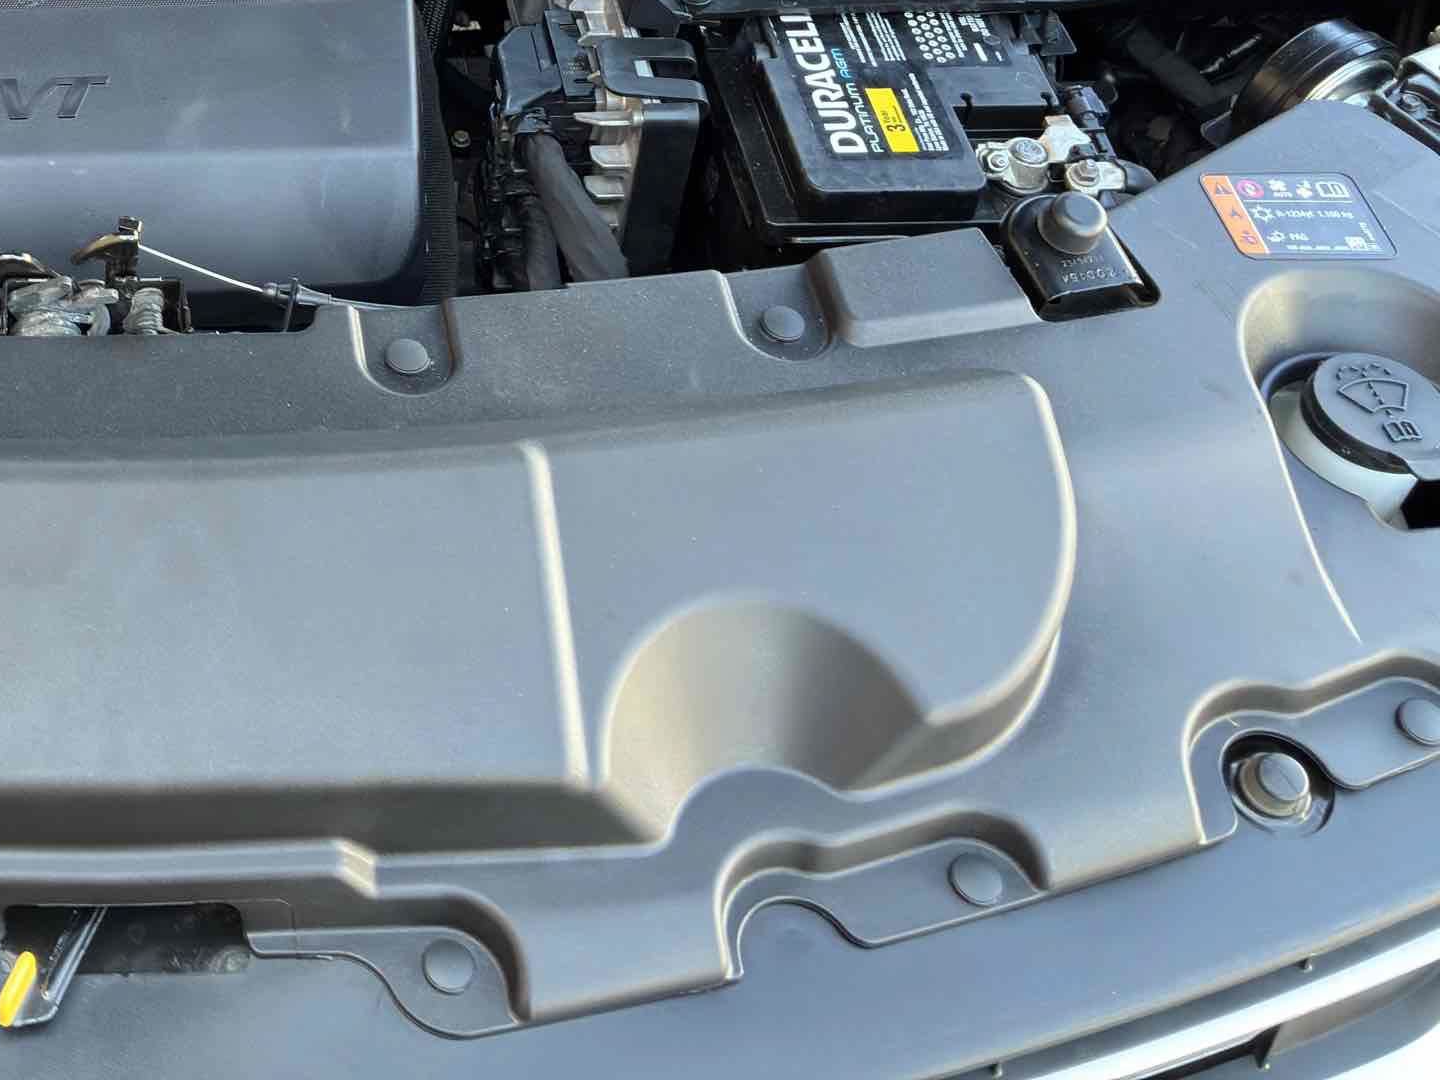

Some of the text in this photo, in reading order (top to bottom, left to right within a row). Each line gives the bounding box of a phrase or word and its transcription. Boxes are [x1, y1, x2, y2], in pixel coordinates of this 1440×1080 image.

[831, 48, 852, 79] AGM
[846, 81, 884, 153] PLATINUM
[886, 123, 906, 133] 3
